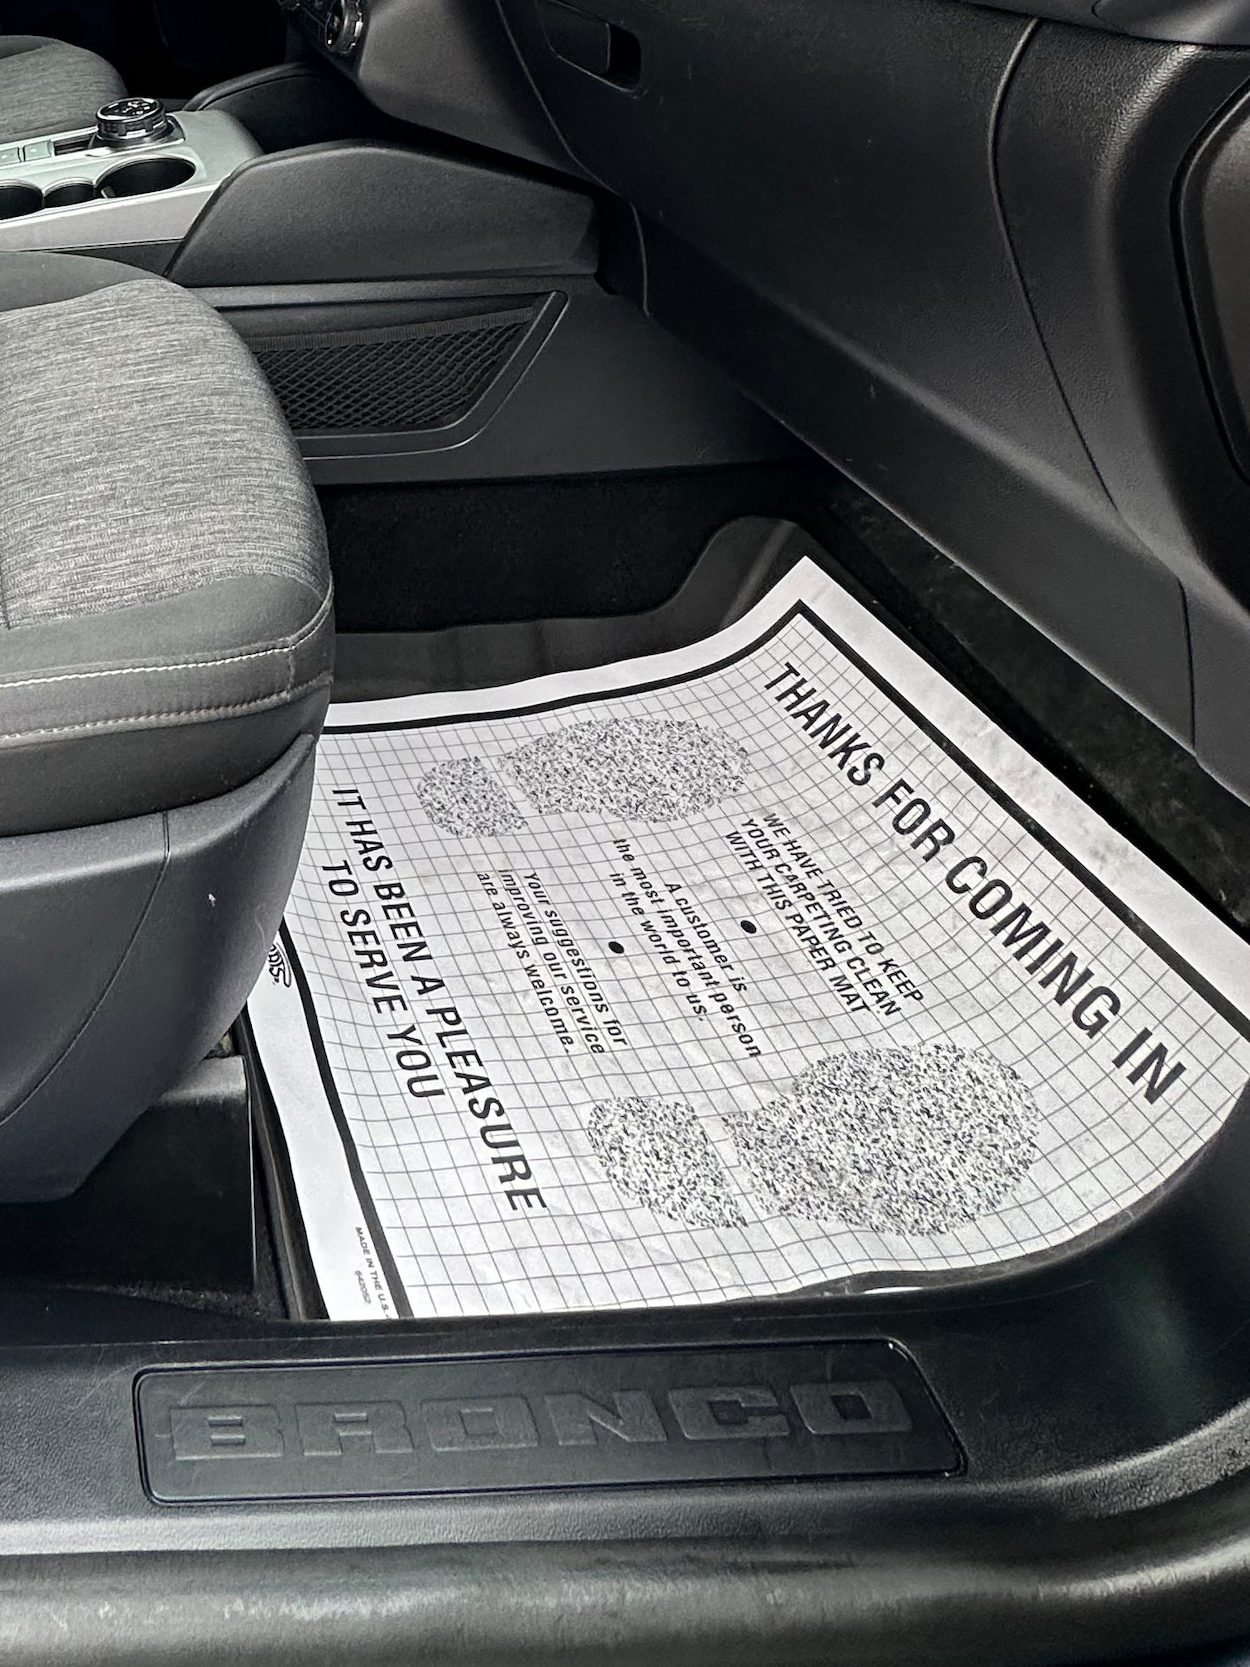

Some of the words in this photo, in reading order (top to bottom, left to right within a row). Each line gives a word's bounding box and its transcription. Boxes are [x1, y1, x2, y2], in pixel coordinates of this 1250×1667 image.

[332, 789, 367, 810] IT
[345, 820, 393, 872] HAS
[322, 859, 359, 897] TO
[373, 882, 433, 962] BEEN
[725, 831, 763, 871] WITH
[757, 873, 793, 910] THIS
[785, 913, 836, 971] PAPER
[829, 975, 871, 1012] MAT
[741, 819, 780, 860] YOUR
[774, 863, 852, 954] CARPETING
[846, 956, 901, 1016] CLEAN
[763, 813, 791, 838] WE
[783, 838, 824, 879] HAVE
[817, 879, 862, 928] TRIED
[858, 931, 884, 955] TO
[878, 958, 924, 1001] KEEP
[764, 661, 885, 786] THANKS
[872, 778, 955, 862] FOR
[945, 856, 1121, 1039] COMING
[1112, 1027, 1187, 1105] IN
[340, 909, 408, 1014] SERVE
[410, 975, 446, 995] A
[477, 873, 498, 896] are
[492, 902, 530, 959] always
[524, 964, 574, 1053] welcome.
[498, 869, 548, 945] improving
[543, 952, 567, 980] our
[560, 985, 605, 1054] service
[524, 872, 551, 905] Your
[545, 910, 609, 1013] suggestions
[603, 1018, 627, 1046] for
[610, 873, 626, 887] in
[622, 891, 645, 916] the
[640, 920, 680, 964] world
[672, 970, 691, 987] to
[686, 994, 707, 1021] us.
[613, 838, 635, 862] the
[631, 867, 665, 904] most
[657, 909, 720, 987] important
[709, 992, 761, 1057] person
[665, 883, 682, 894] A
[675, 897, 734, 972] customer
[729, 976, 747, 992] is
[386, 1024, 445, 1098] YOU
[425, 1007, 547, 1211] PLEASURE
[355, 1227, 371, 1255] MADE
[366, 1258, 375, 1268] IN
[370, 1270, 383, 1291] THE
[170, 1382, 913, 1460] BRONCO
